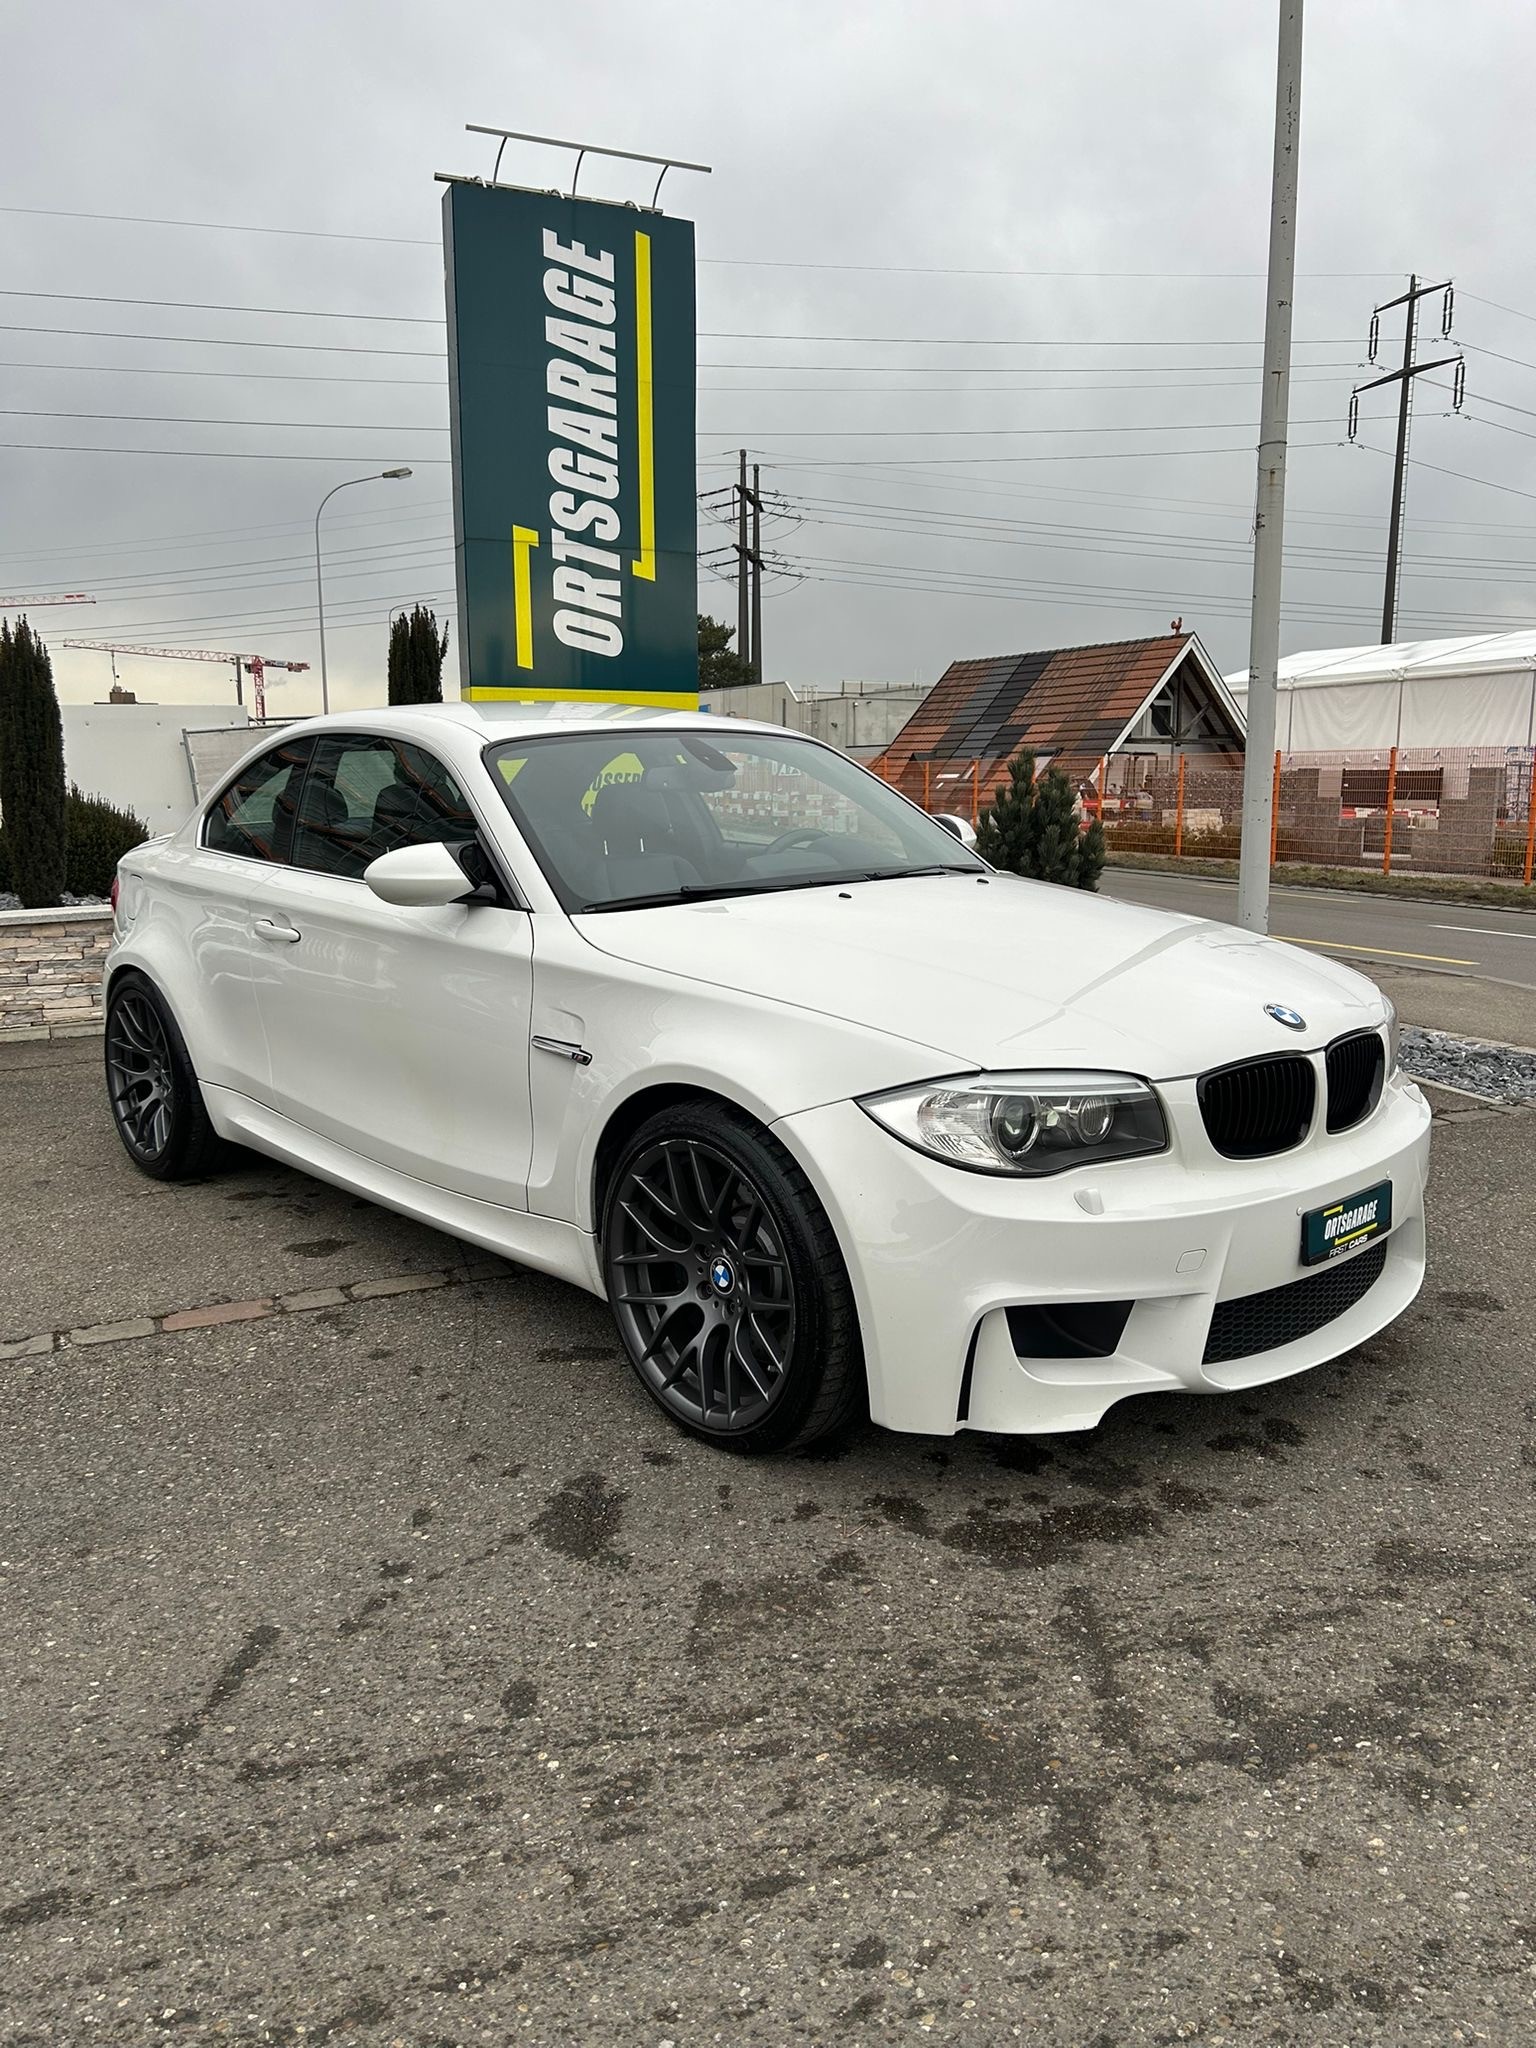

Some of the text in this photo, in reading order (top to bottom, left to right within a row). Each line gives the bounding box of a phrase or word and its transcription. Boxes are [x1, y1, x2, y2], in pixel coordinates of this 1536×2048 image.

[542, 227, 624, 658] ORTSGARAGE
[1324, 1199, 1378, 1240] ORTSGARAGE
[1328, 1233, 1369, 1258] FIRST CARS
